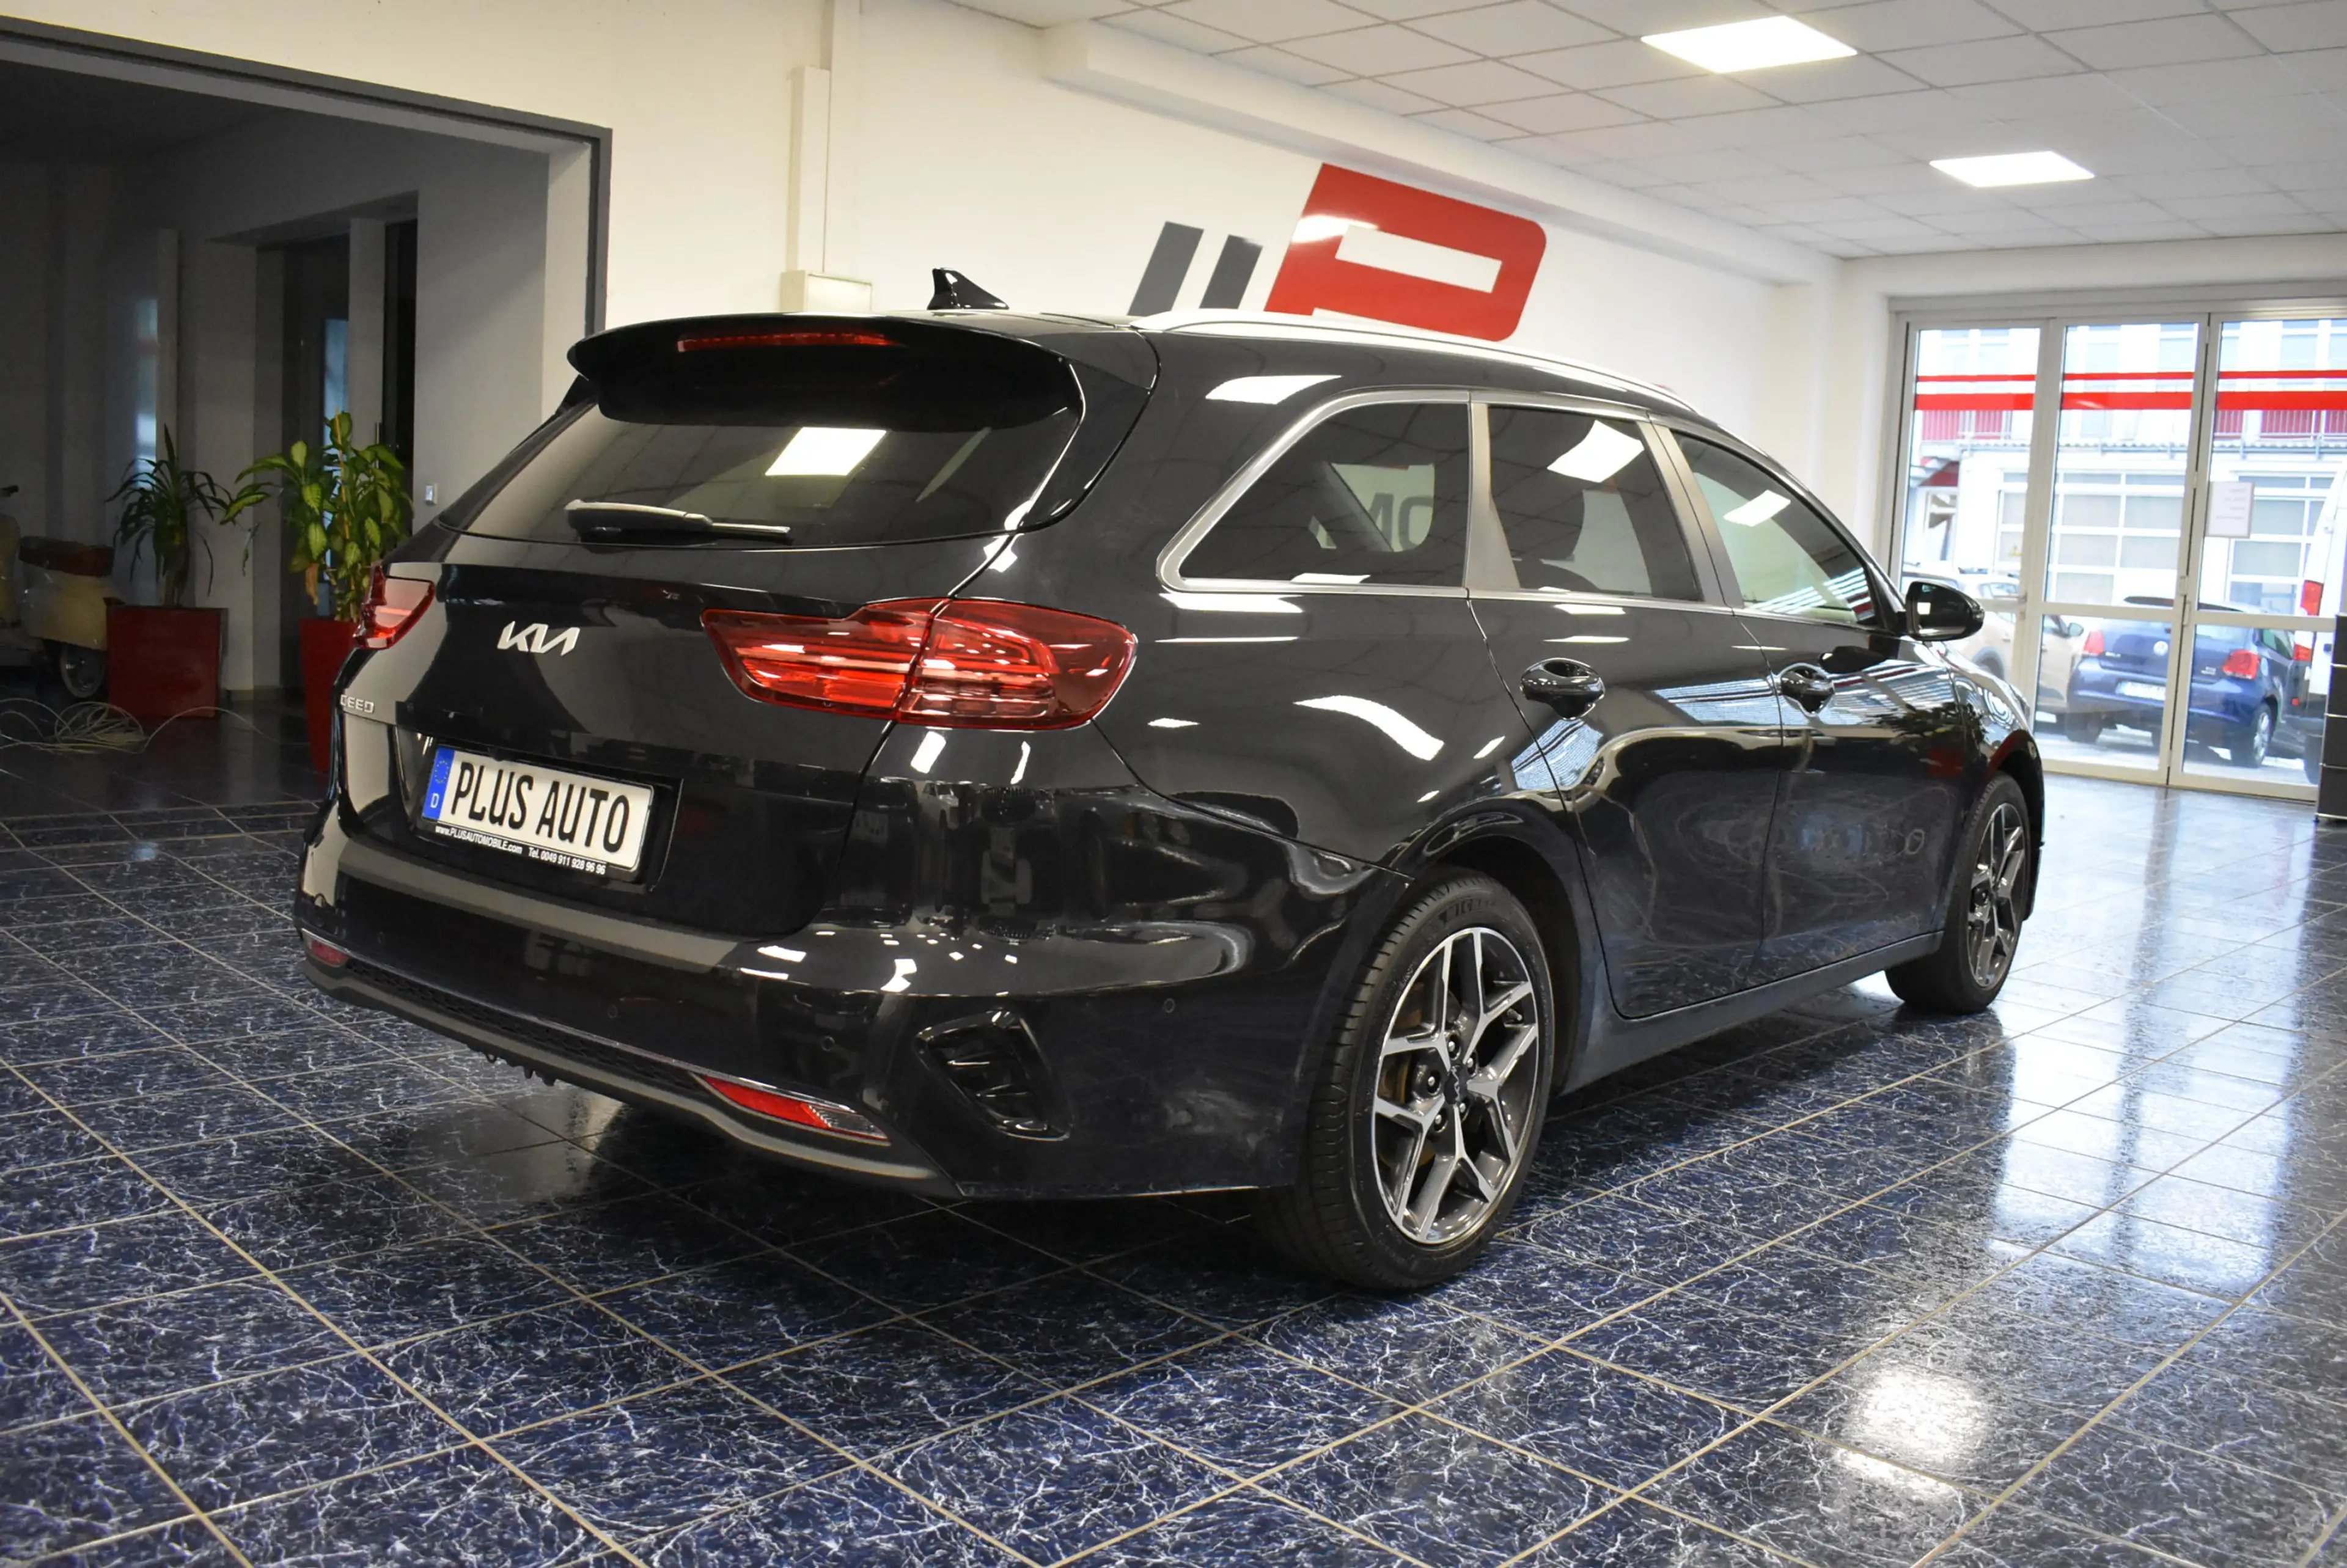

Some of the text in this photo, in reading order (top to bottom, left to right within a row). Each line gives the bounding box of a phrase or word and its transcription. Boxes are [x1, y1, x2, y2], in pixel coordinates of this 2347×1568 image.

[498, 621, 581, 656] KIA
[340, 694, 375, 714] CEED
[430, 794, 439, 809] D
[450, 761, 630, 852] PLUS AUTO
[540, 851, 557, 863] 0049
[557, 854, 571, 866] 911
[571, 858, 585, 870] 928
[586, 862, 595, 873] 96
[596, 864, 606, 875] 96
